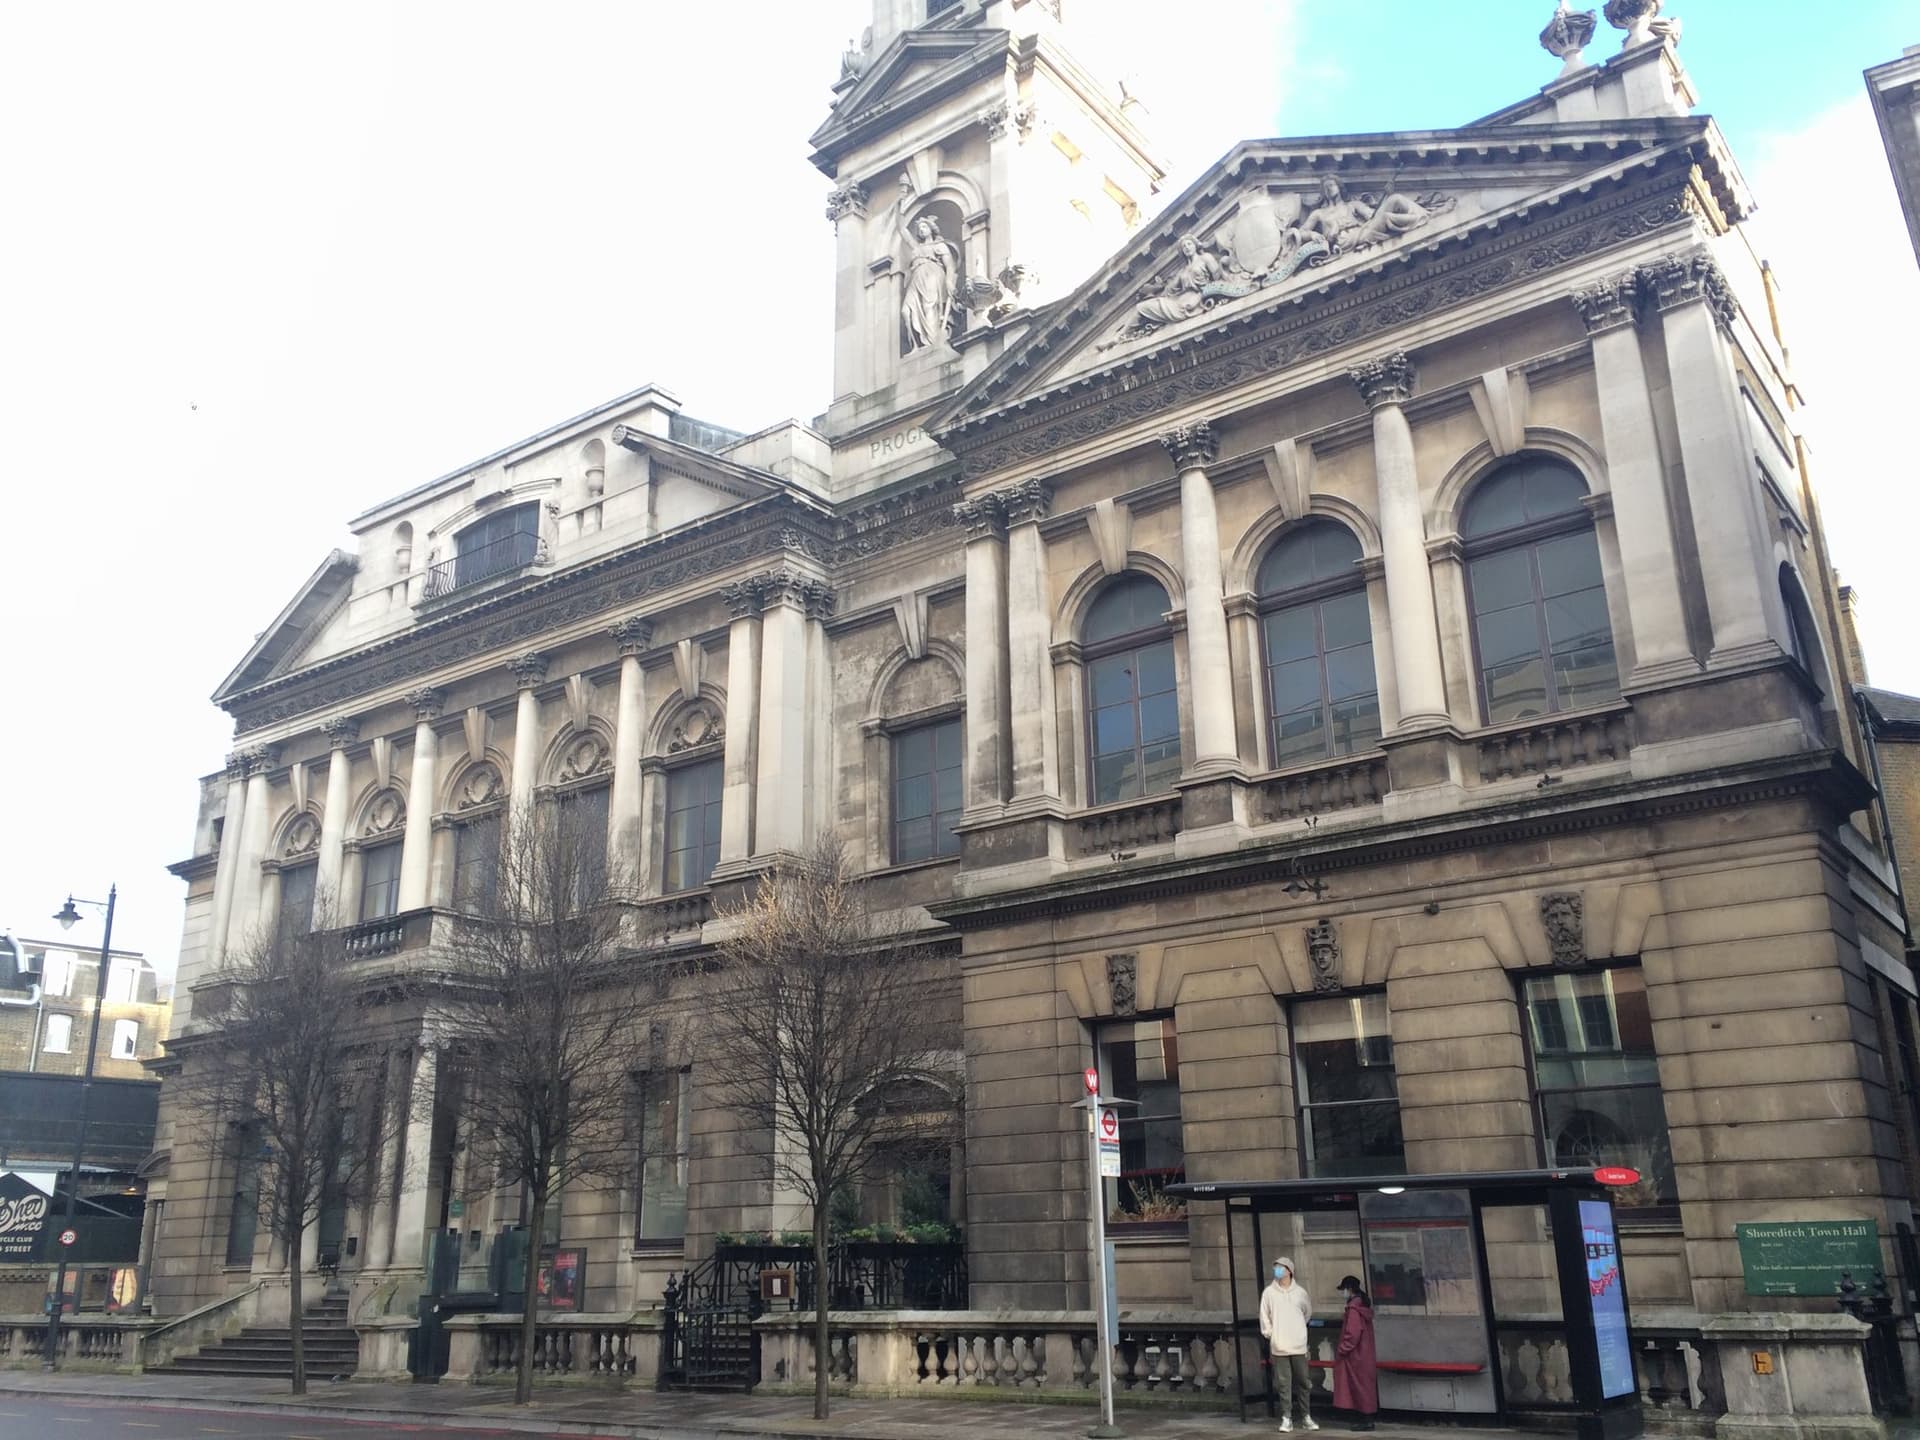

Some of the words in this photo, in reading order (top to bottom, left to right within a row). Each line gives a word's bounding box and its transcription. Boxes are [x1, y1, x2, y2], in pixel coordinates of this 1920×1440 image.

[1087, 1073, 1098, 1088] W
[63, 1232, 75, 1242] 20
[1745, 1227, 1806, 1239] Shoreditch
[1808, 1226, 1840, 1238] Town
[1841, 1225, 1867, 1237] Hall
[4, 1245, 32, 1253] STREET
